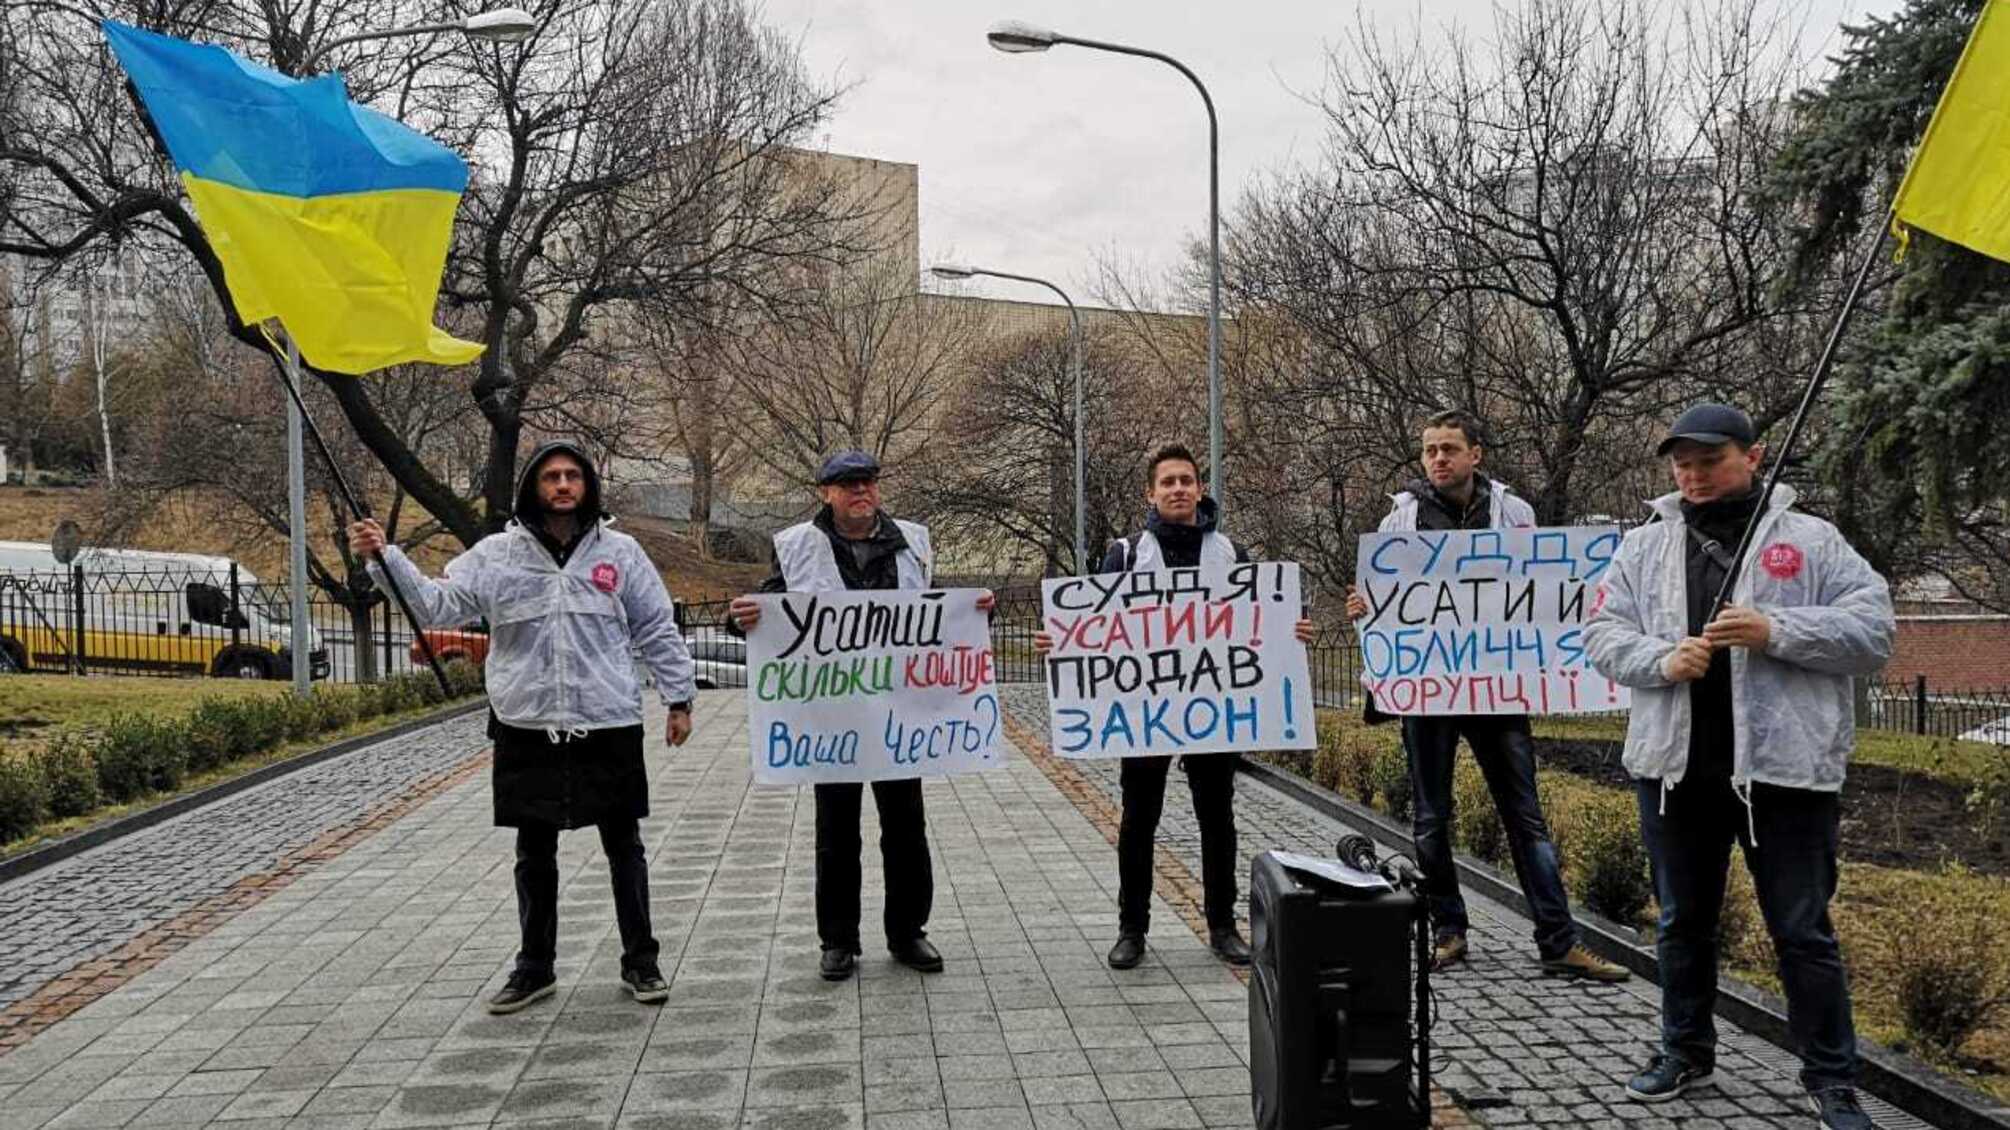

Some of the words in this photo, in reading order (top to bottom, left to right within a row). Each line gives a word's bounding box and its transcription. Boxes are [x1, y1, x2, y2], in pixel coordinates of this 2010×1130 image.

[1370, 532, 1617, 580] СУДДЯ
[1052, 563, 1284, 613] СУДДЯ!
[1050, 599, 1262, 653] УСАТИЙ!
[1049, 646, 1263, 699] ПРОДАВ
[768, 721, 858, 768] Ваша
[885, 694, 998, 763] Честь?
